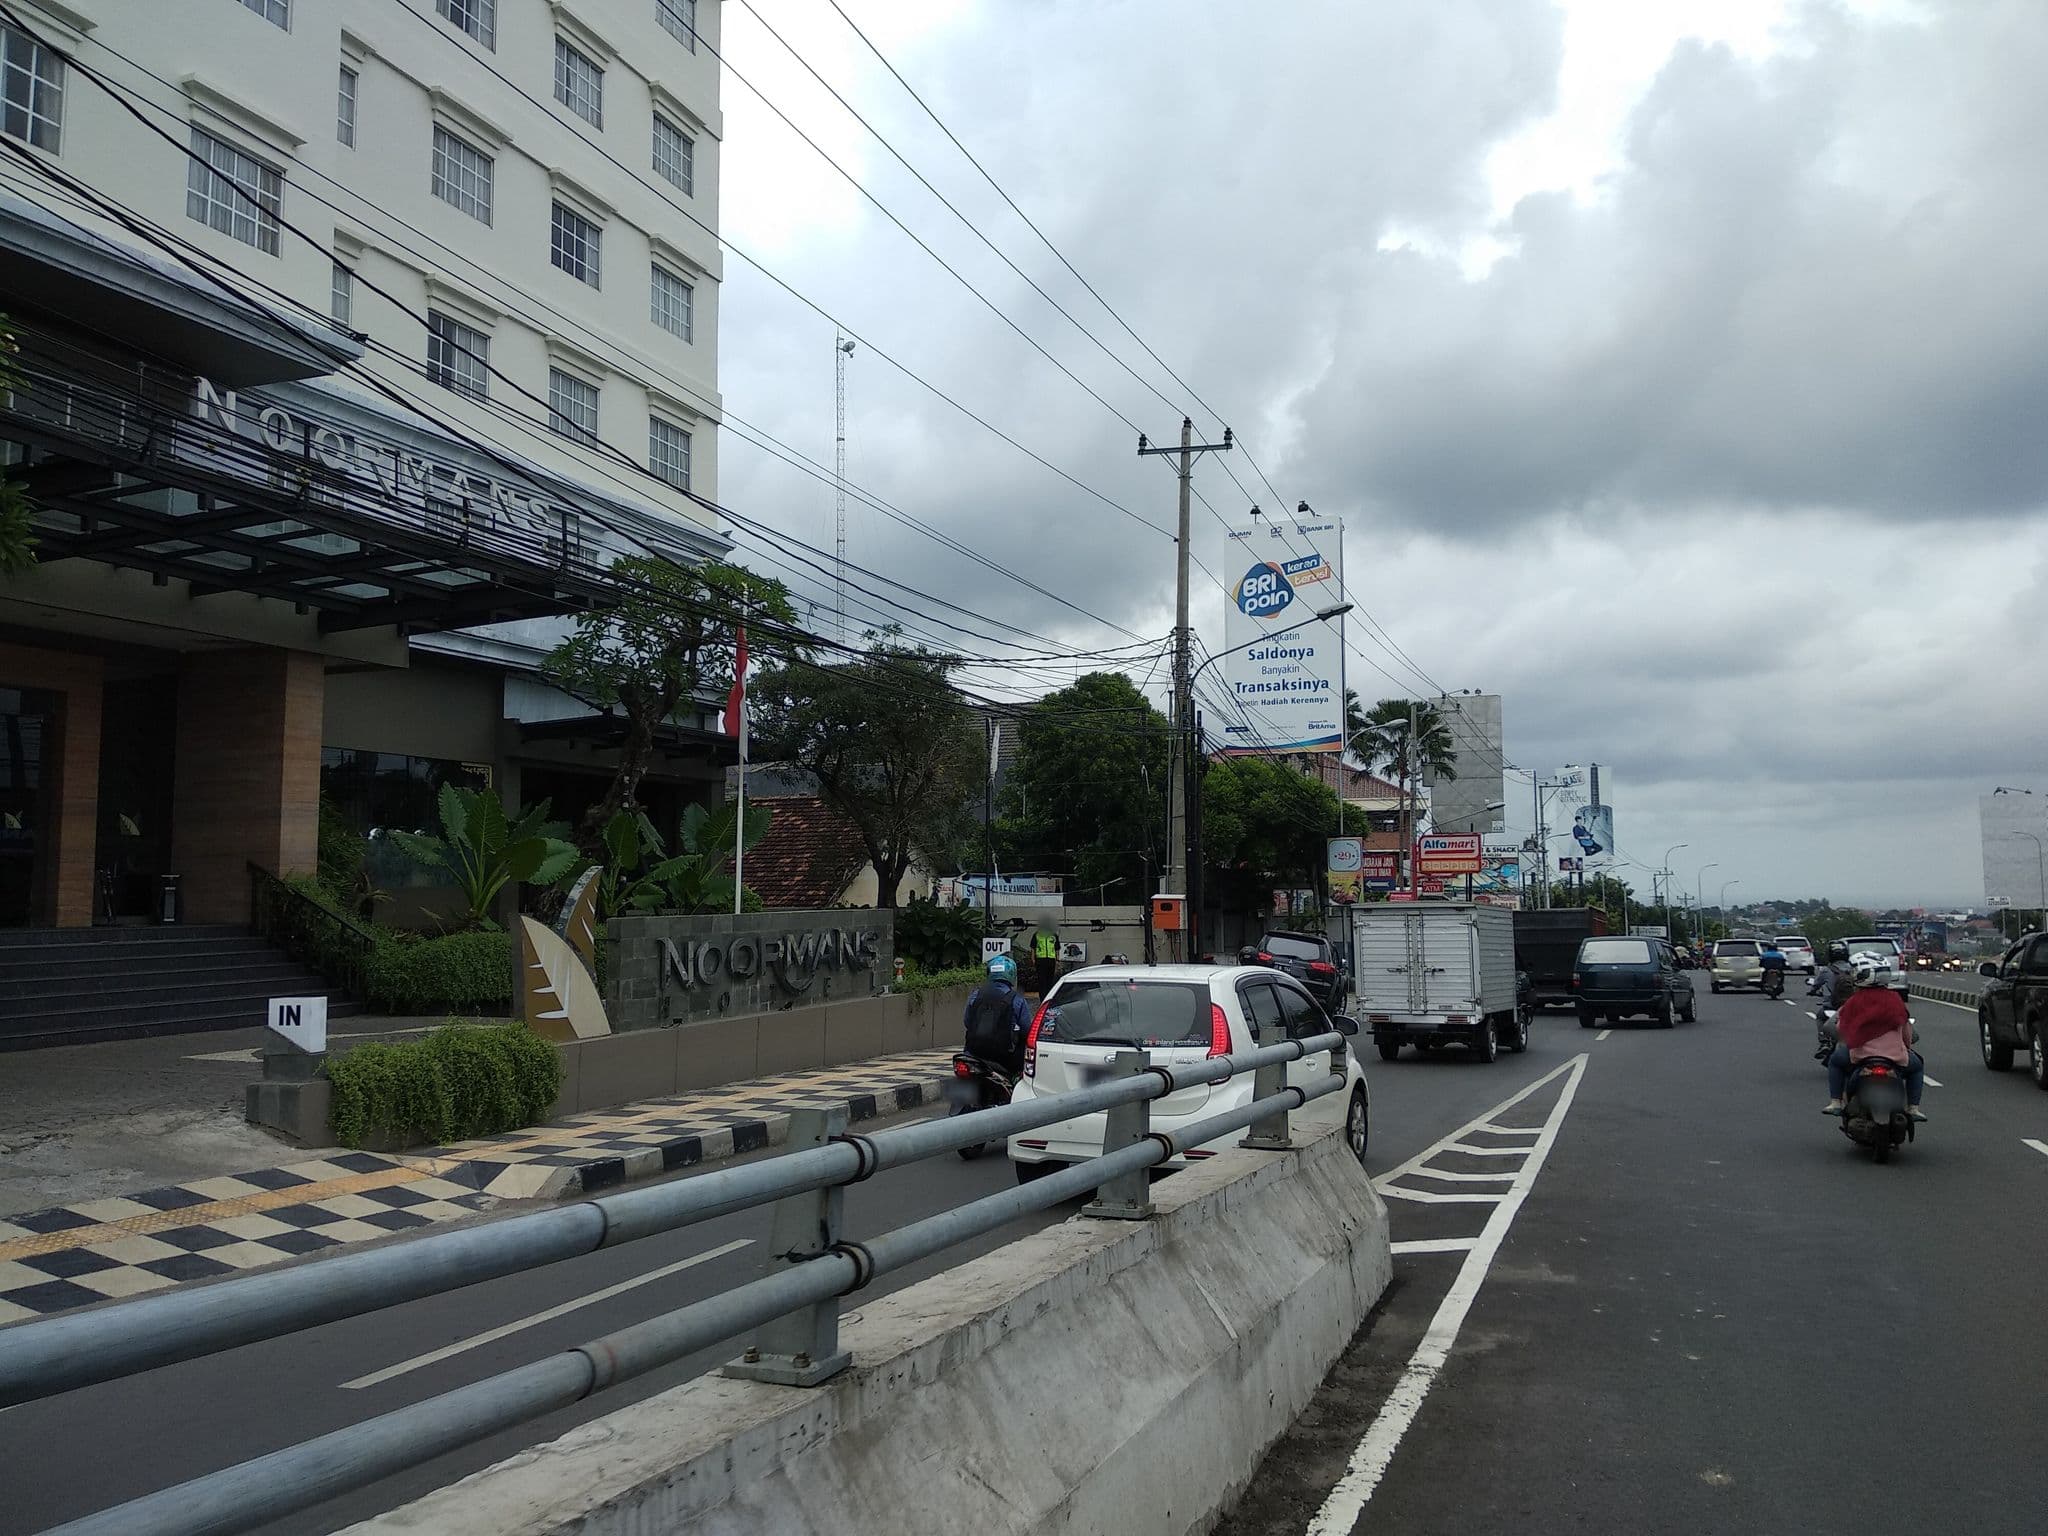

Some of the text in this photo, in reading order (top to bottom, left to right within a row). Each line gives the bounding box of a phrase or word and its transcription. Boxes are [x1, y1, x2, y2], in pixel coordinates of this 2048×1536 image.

[194, 375, 551, 530] NOORMANS
[1242, 572, 1277, 597] BRI
[1245, 590, 1289, 615] poin
[1248, 647, 1314, 661] Saldonya
[1261, 664, 1300, 676] Banyakin
[1235, 678, 1329, 693] Transaksinya
[1261, 698, 1288, 706] Hadiah
[1291, 697, 1329, 705] Kerennya
[1423, 839, 1476, 849] Alfamart
[1337, 850, 1352, 861] 29
[1008, 884, 1036, 894] KAMBING
[985, 941, 1004, 952] OUT
[656, 928, 879, 992] NOORMANS
[278, 1005, 301, 1026] IN
